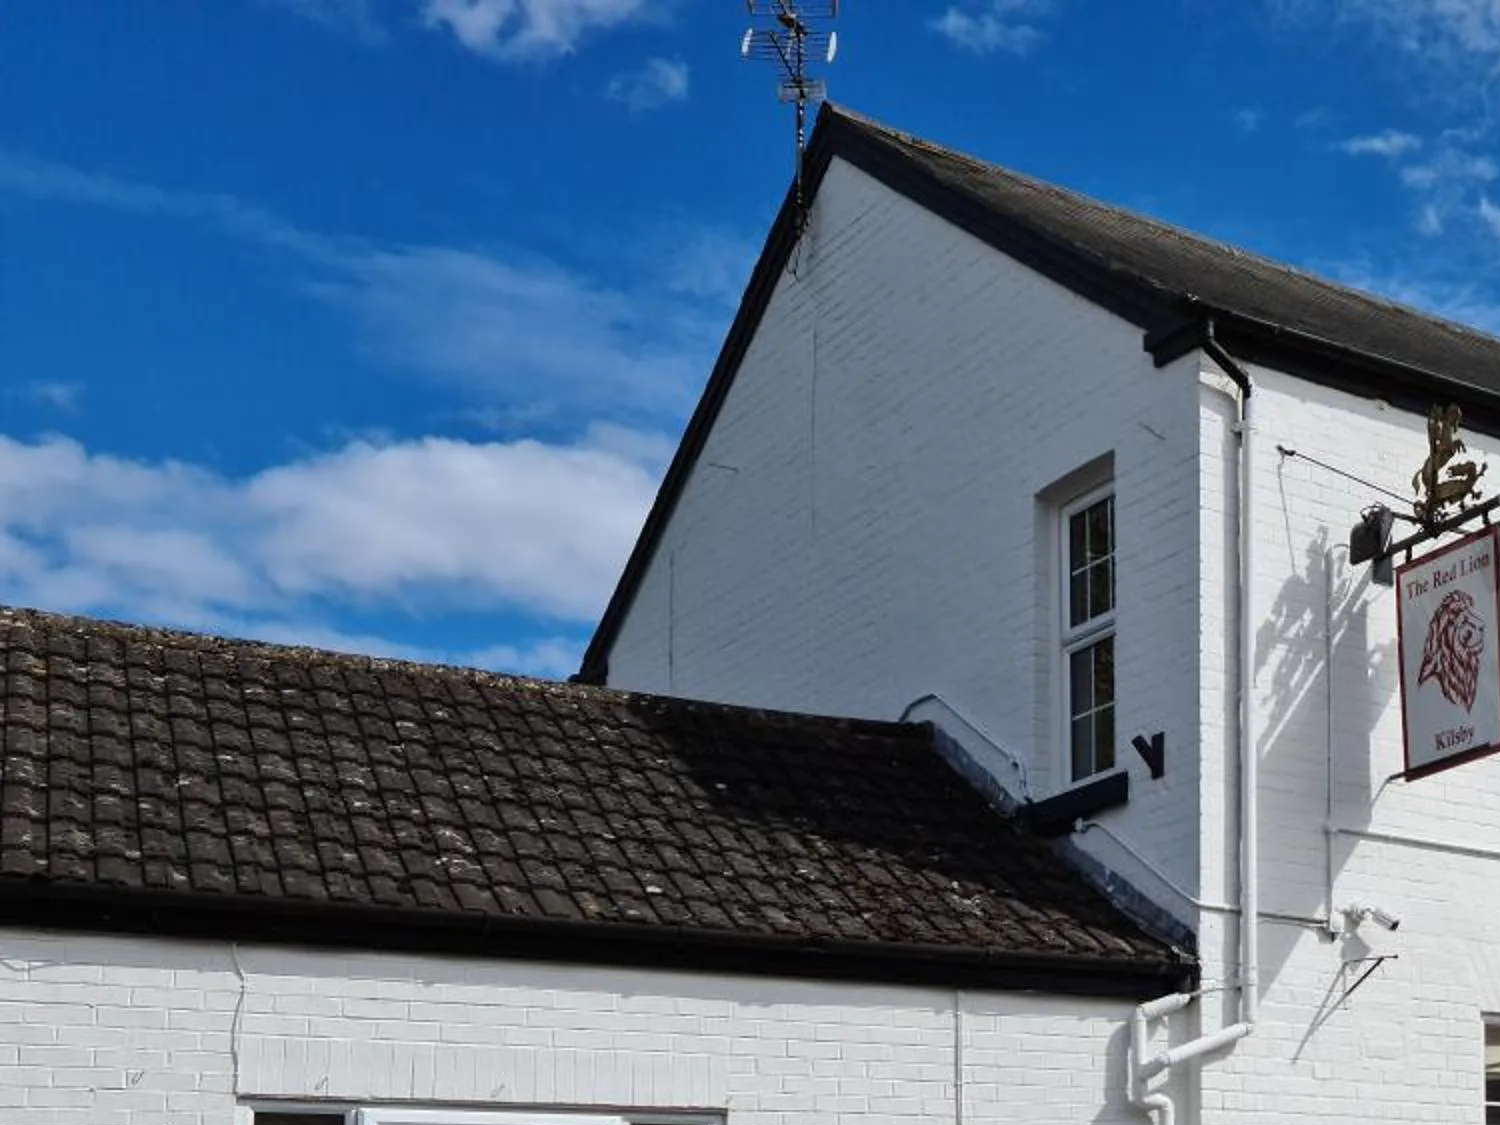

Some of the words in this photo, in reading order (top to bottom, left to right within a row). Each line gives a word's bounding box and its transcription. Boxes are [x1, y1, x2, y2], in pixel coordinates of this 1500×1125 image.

[1407, 576, 1429, 601] The
[1433, 563, 1457, 589] Red
[1460, 553, 1490, 578] Lion
[1435, 725, 1474, 750] Kilsby
